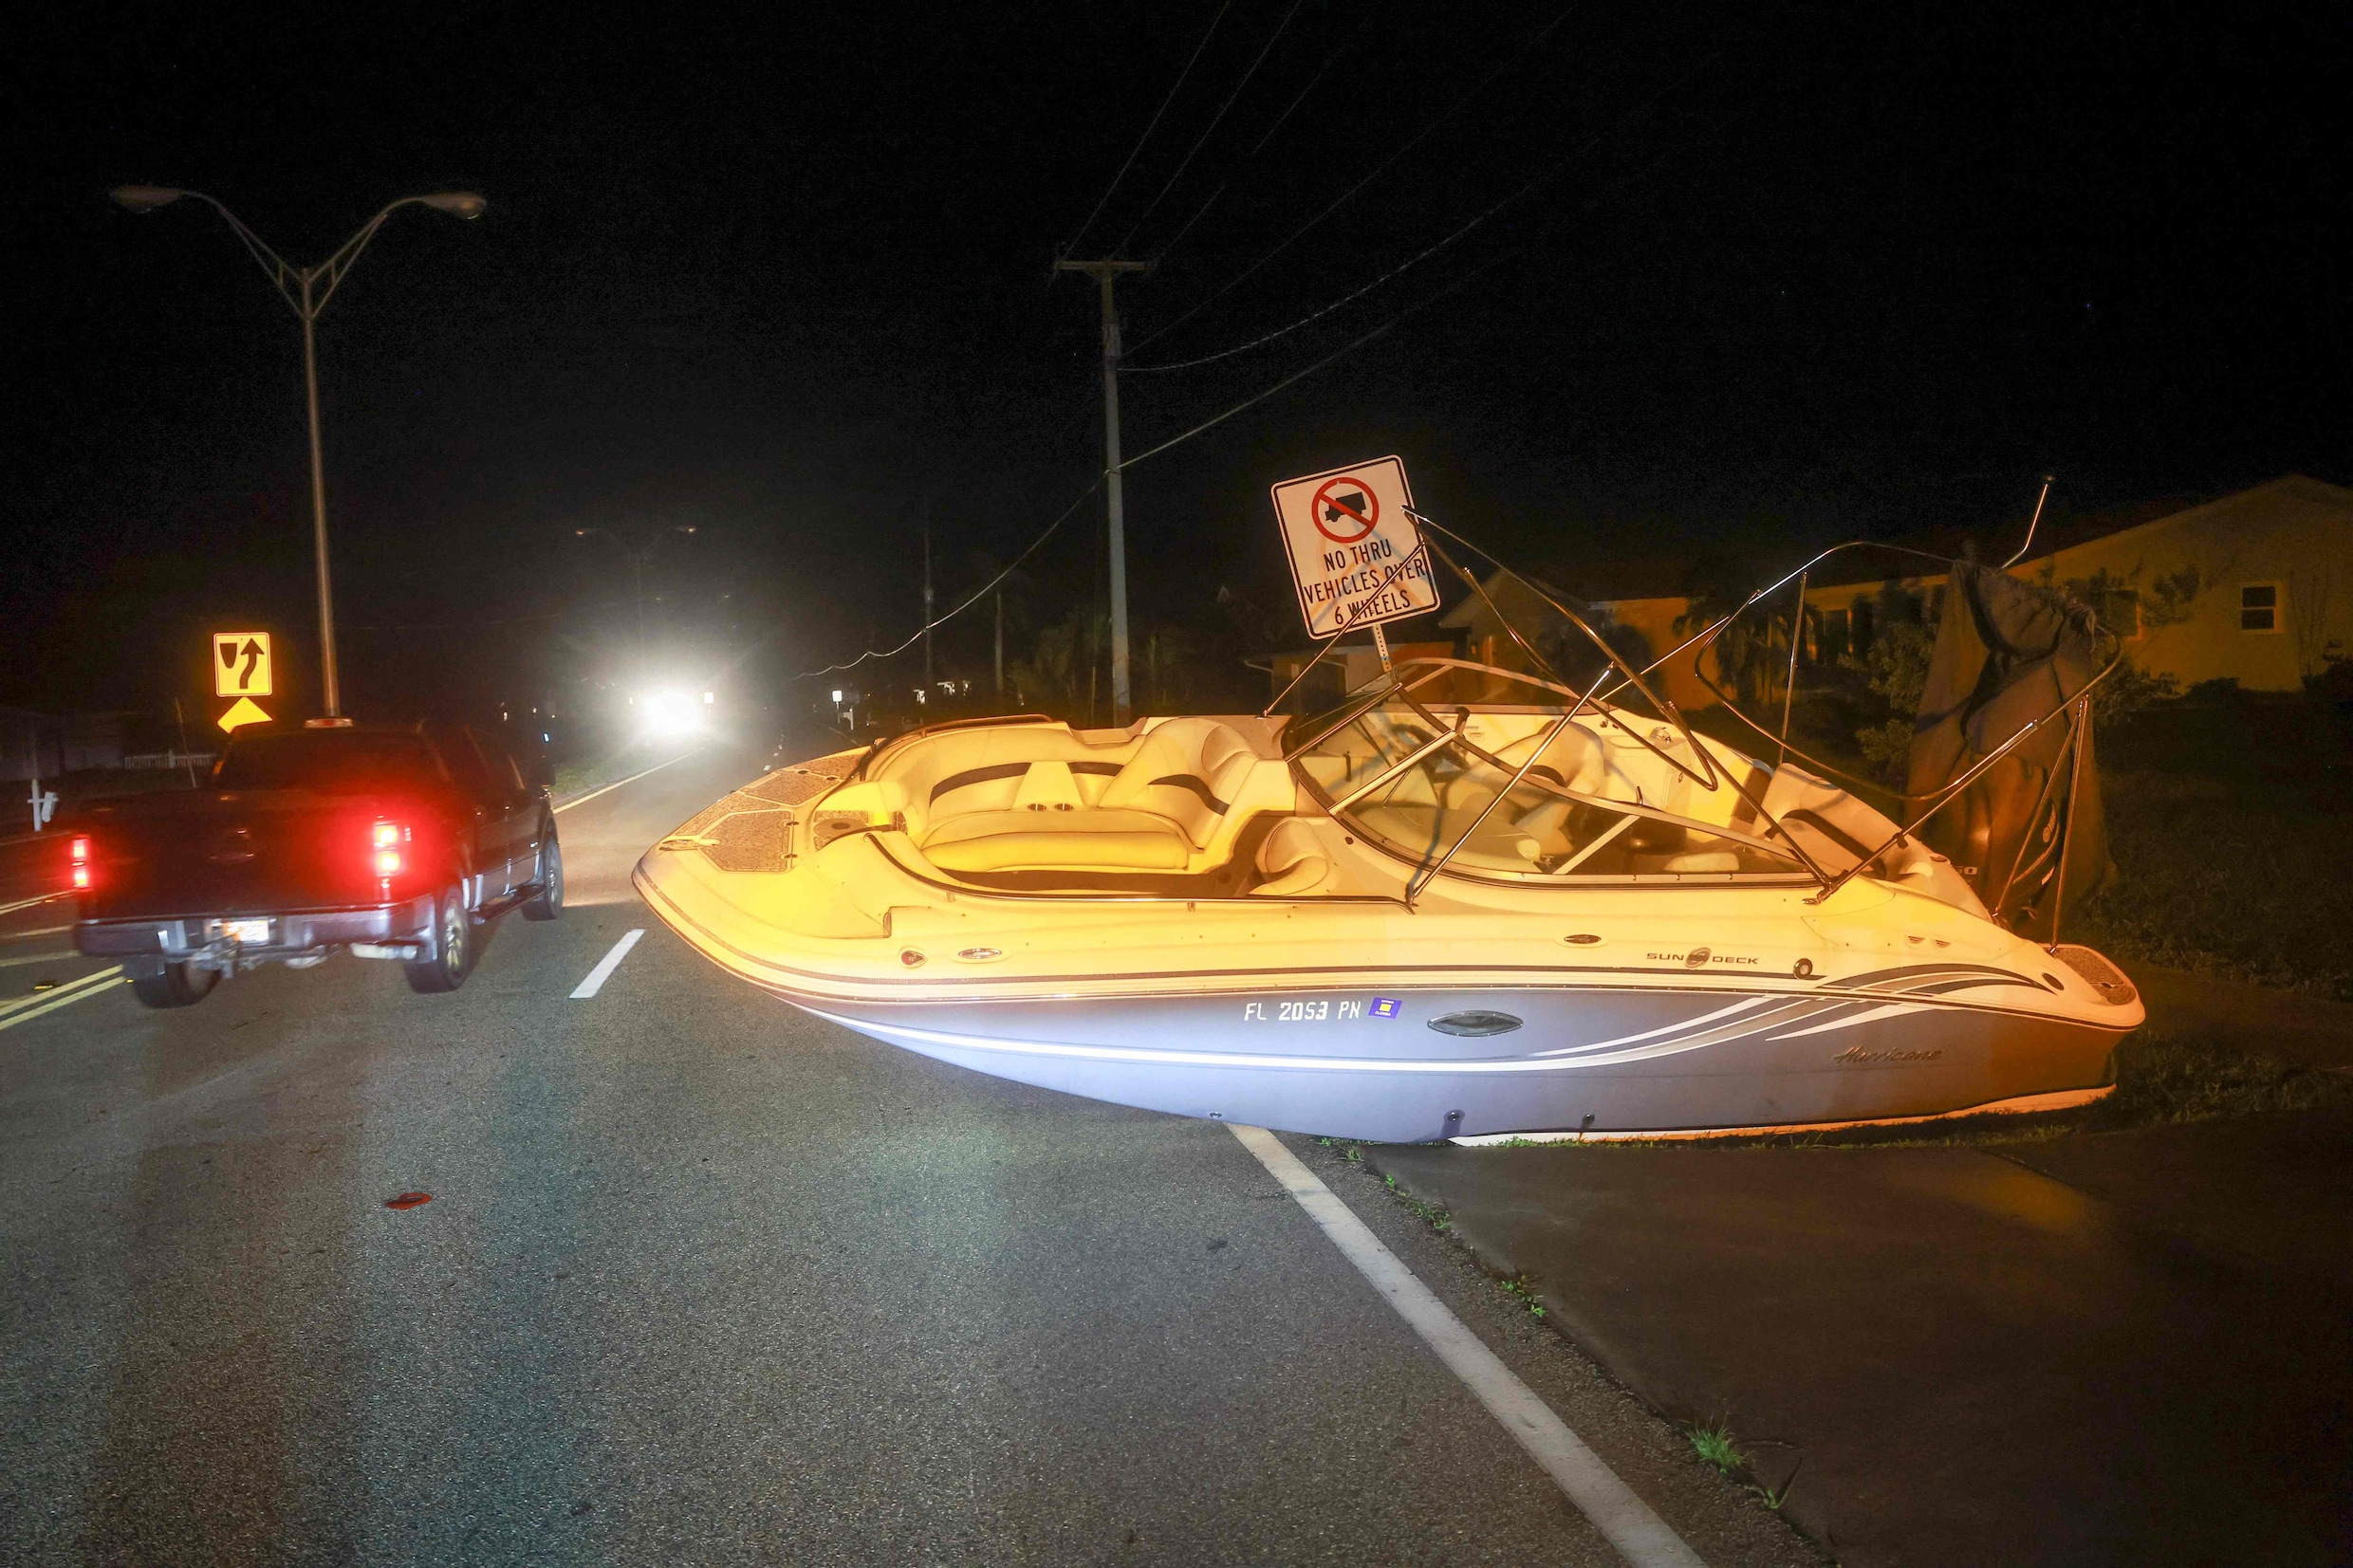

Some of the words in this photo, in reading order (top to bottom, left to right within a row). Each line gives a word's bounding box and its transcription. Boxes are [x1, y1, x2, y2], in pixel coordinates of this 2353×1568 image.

[1324, 550, 1346, 572] NO
[1349, 539, 1392, 565] THRU
[1304, 569, 1380, 604] VEHICLES
[1384, 559, 1426, 584] OVER
[1334, 605, 1344, 625] 6
[1347, 589, 1411, 619] WHEELS
[1646, 952, 1684, 961] SUN
[1712, 955, 1759, 965] DECK
[1244, 1002, 1268, 1022] FL
[1337, 1001, 1362, 1020] PN
[1833, 1045, 1942, 1064] Hurricane
